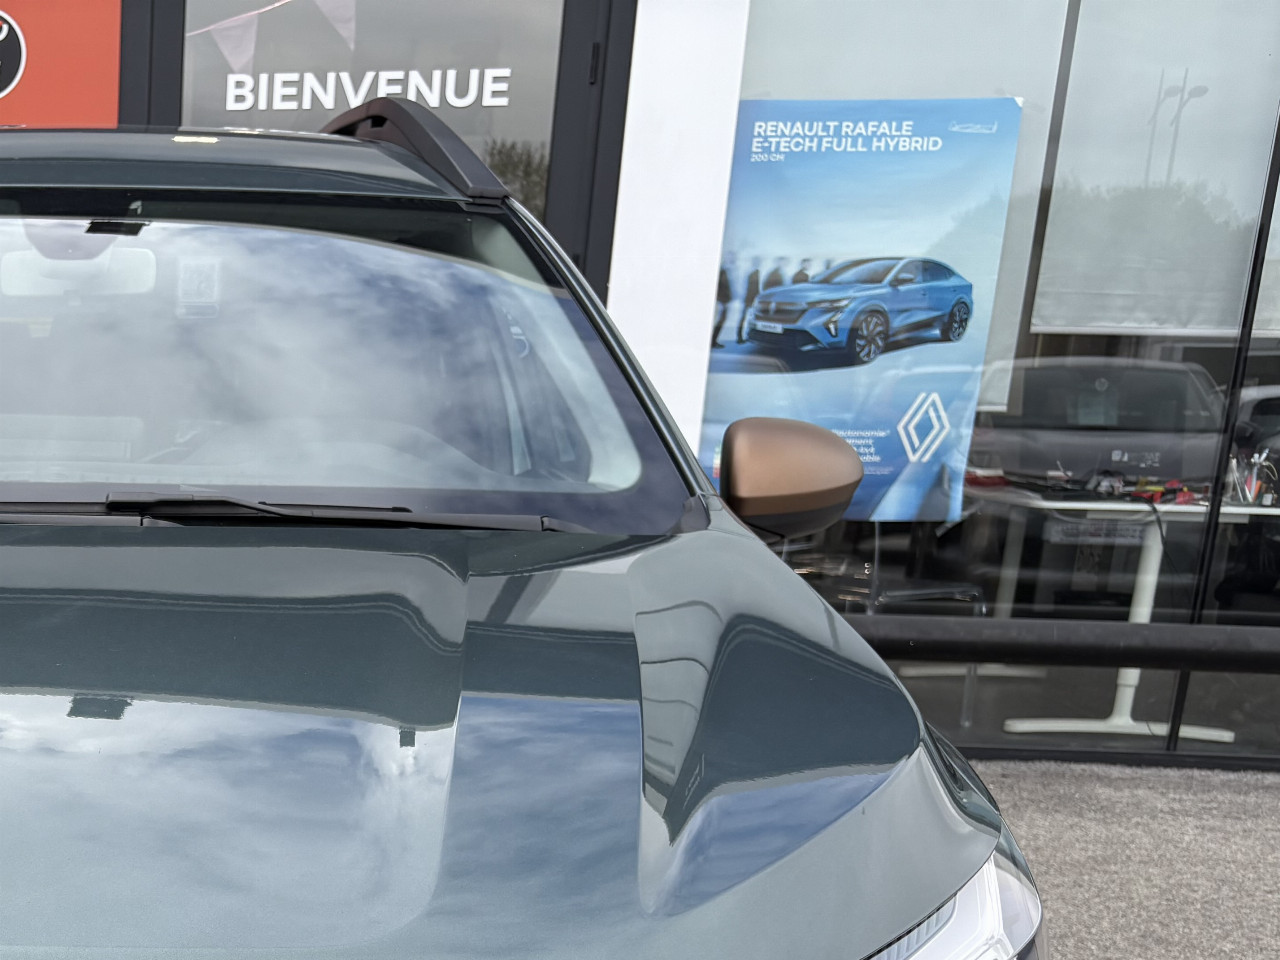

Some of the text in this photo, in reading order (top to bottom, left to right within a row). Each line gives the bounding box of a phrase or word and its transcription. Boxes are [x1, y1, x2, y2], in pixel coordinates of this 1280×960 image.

[225, 68, 511, 111] BIENVENUE
[754, 121, 913, 136] RENAULT RAFALE
[751, 136, 943, 152] E-TECH FULL HYBRID
